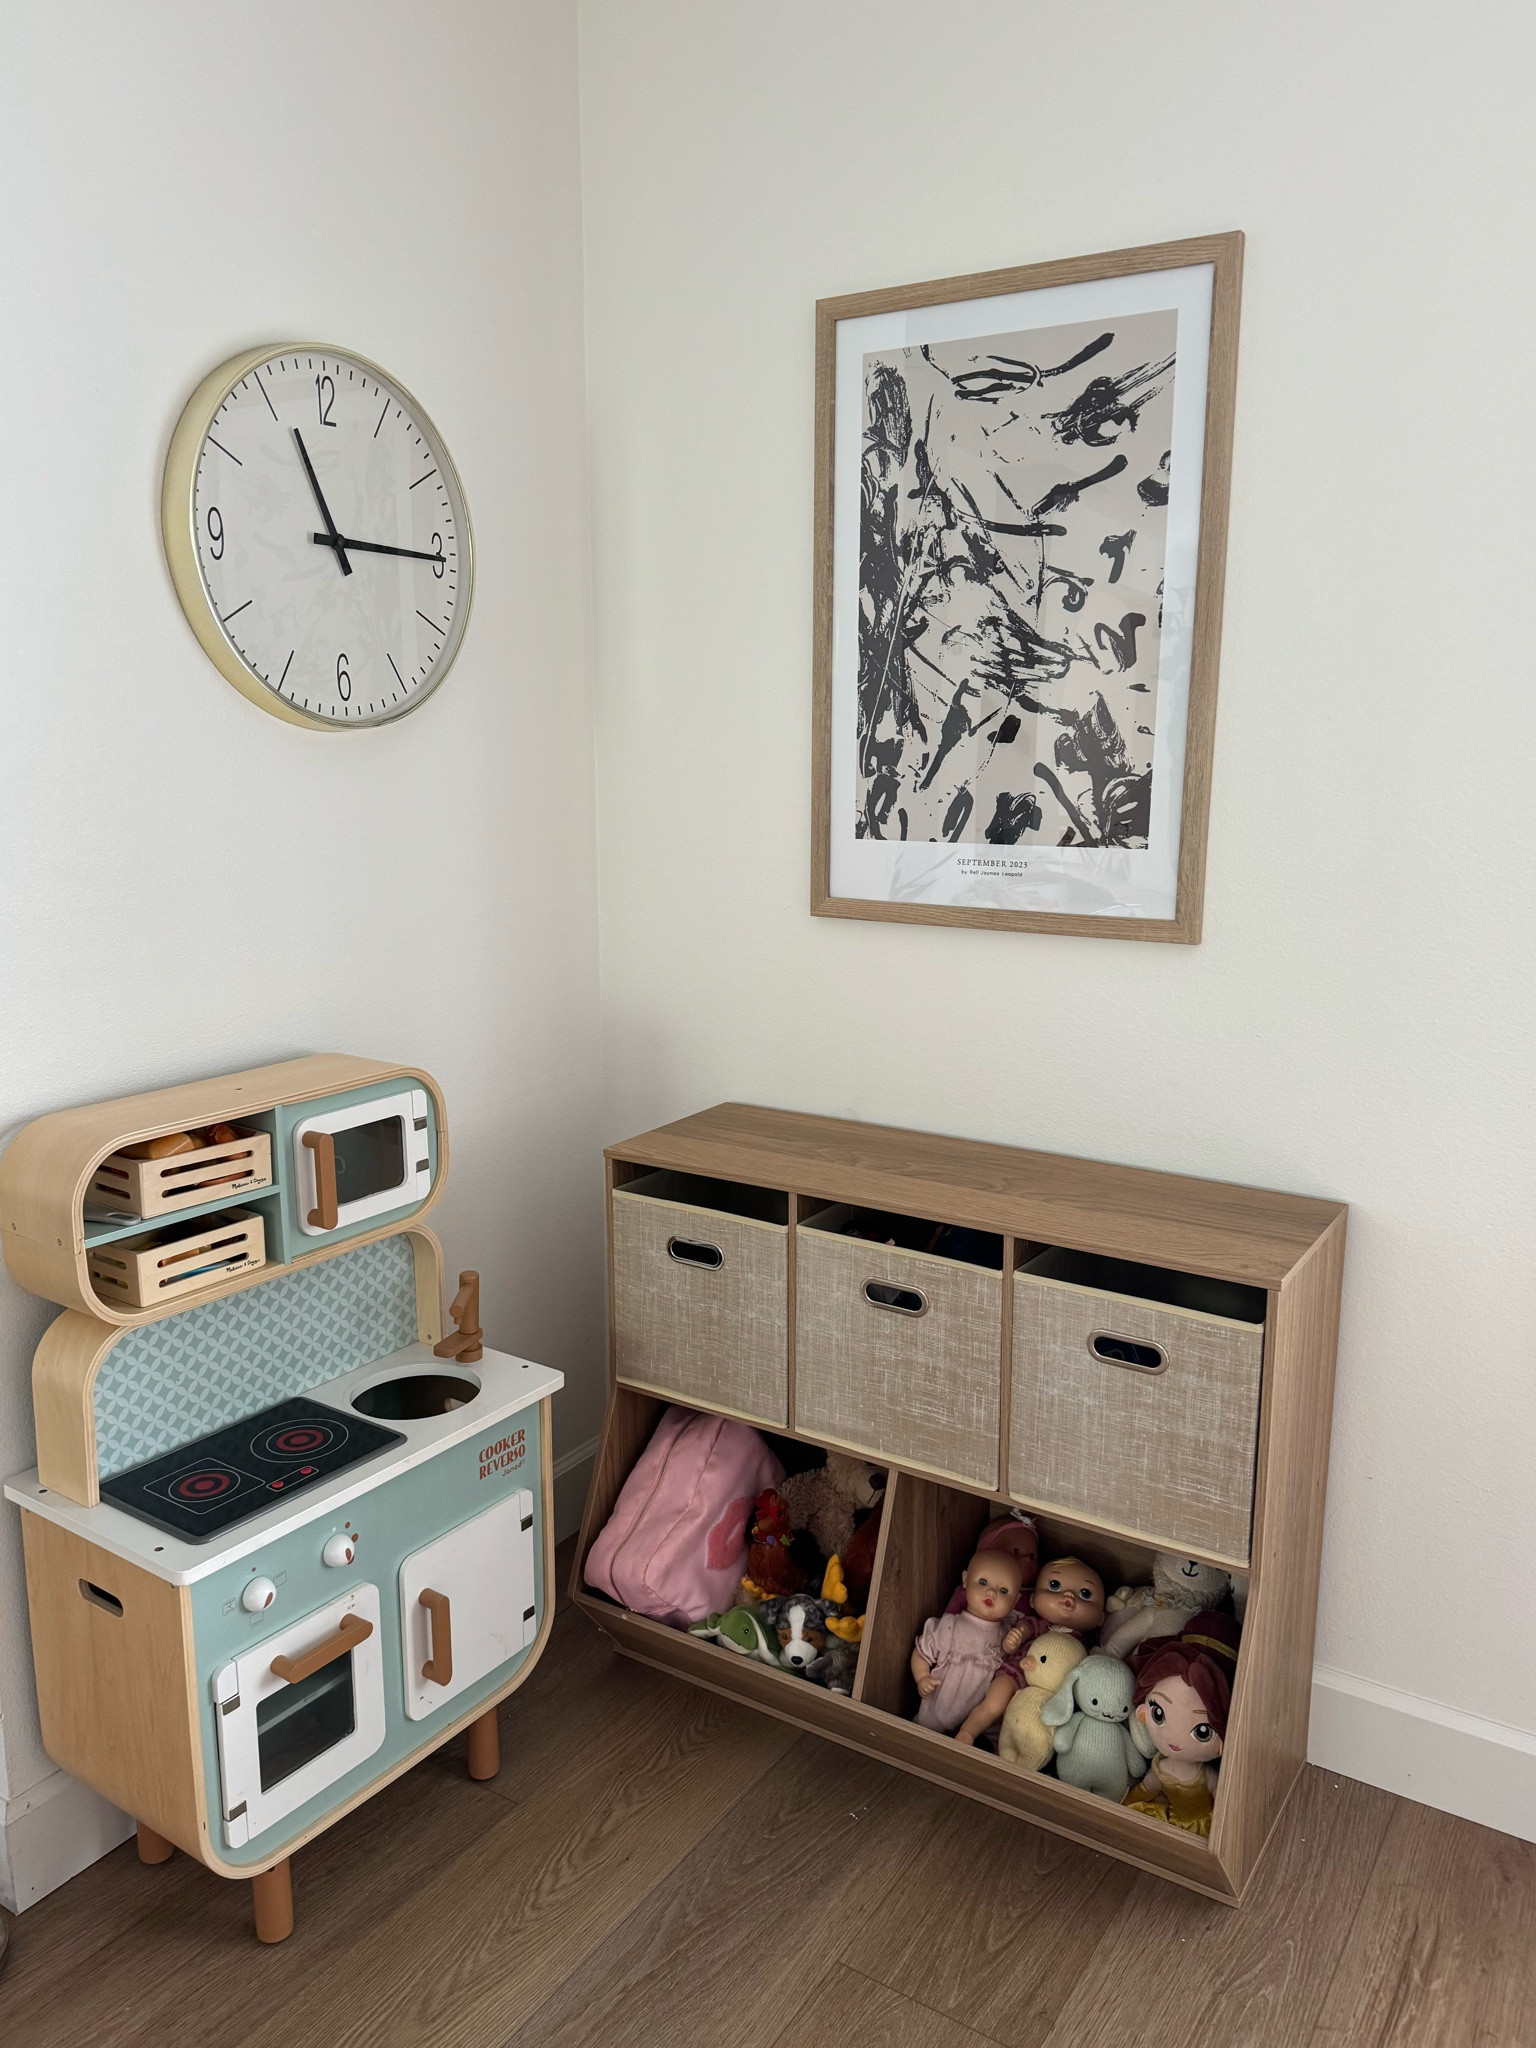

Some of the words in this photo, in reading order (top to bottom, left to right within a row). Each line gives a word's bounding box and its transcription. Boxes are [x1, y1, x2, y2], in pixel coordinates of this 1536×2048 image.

[315, 373, 337, 427] 12
[207, 506, 225, 560] 9
[431, 532, 445, 579] 3
[336, 653, 352, 701] 6
[957, 858, 1007, 868] SEPTEMBER
[1009, 861, 1028, 869] 2023
[478, 1429, 526, 1463] COOKER
[478, 1444, 526, 1481] REVERSO
